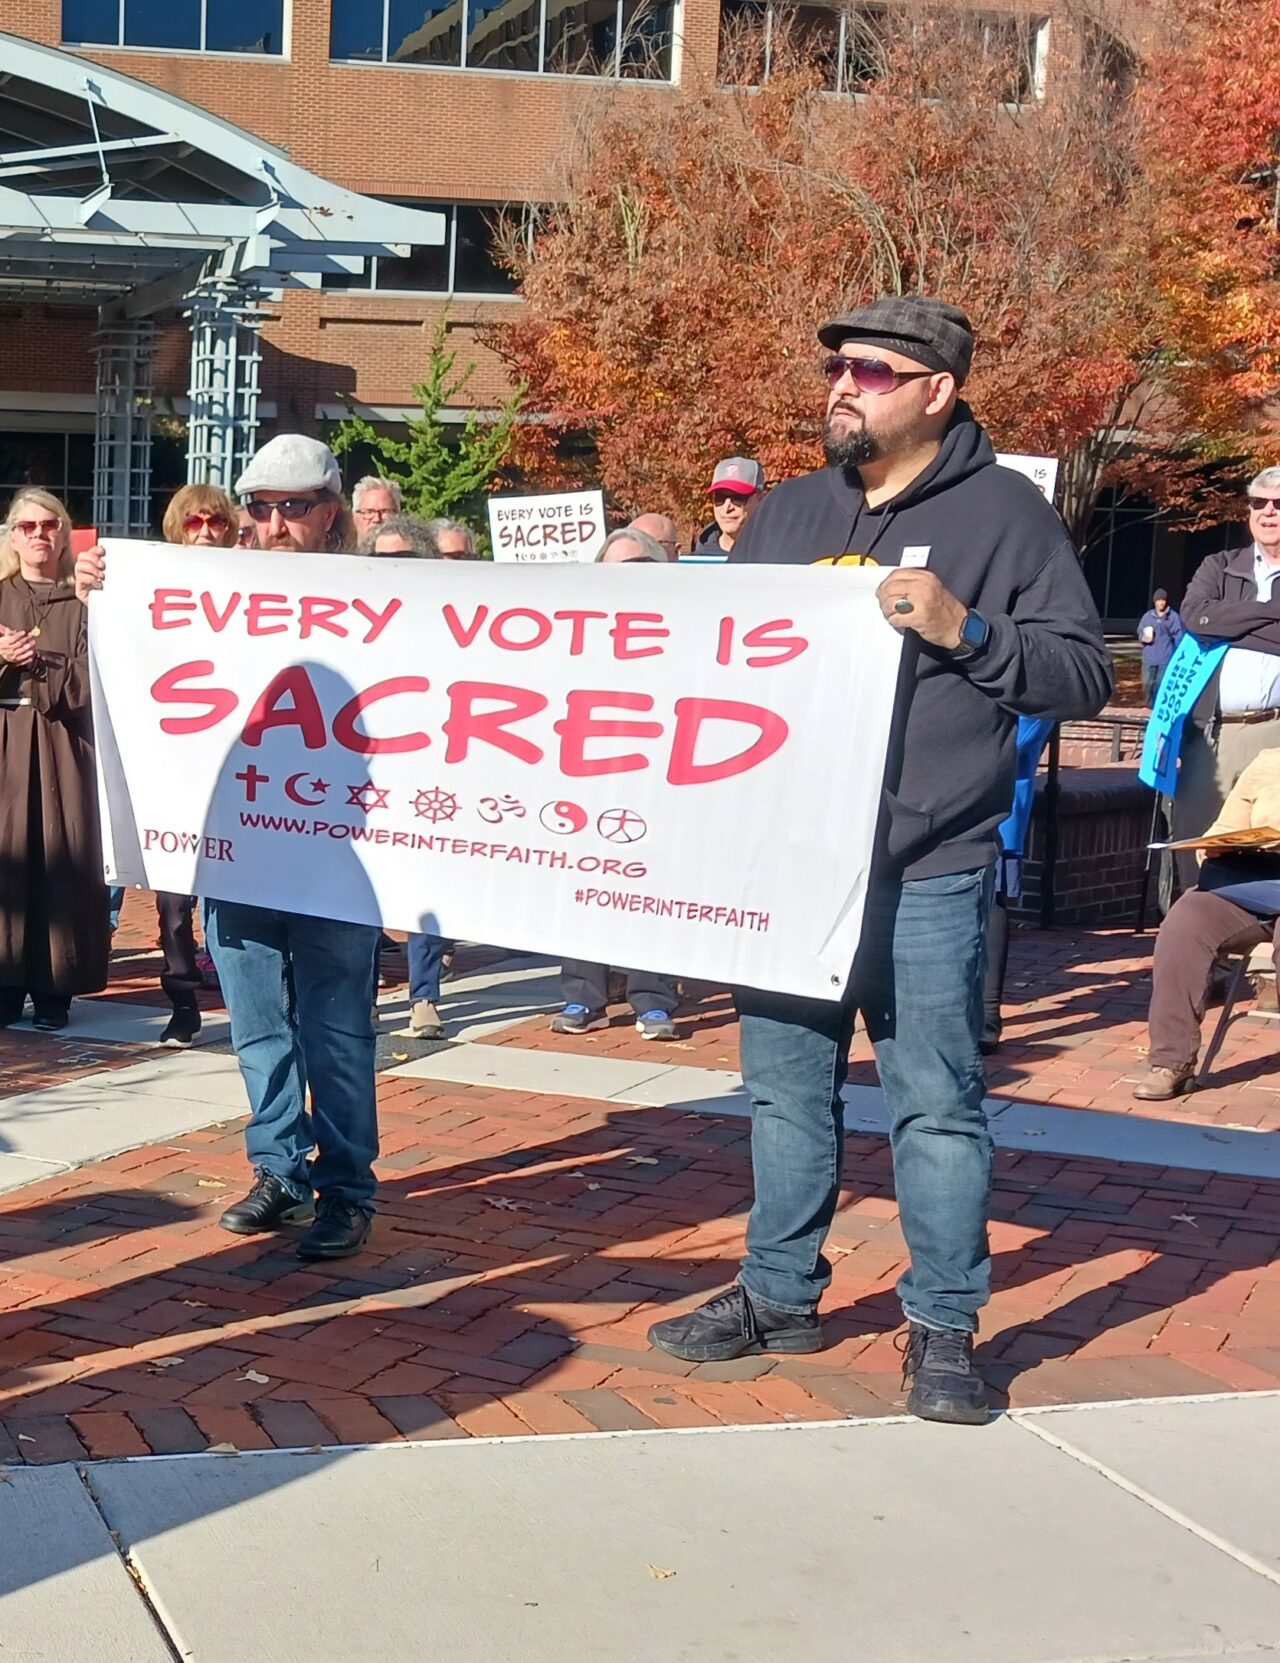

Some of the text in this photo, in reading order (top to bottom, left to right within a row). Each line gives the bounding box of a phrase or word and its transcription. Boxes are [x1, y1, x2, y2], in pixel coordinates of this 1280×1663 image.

[1034, 469, 1047, 479] IS
[497, 503, 594, 521] EVERY VOTE IS
[499, 521, 596, 548] SACRED
[149, 588, 809, 667] EVERY VOTE IS
[1162, 666, 1188, 723] VOTE
[150, 659, 789, 786] SACRED
[143, 828, 235, 863] POWER
[239, 812, 648, 878] WWW.POWERINTERFAITH.ORG
[574, 888, 770, 933] #POWERINTERFAITH
